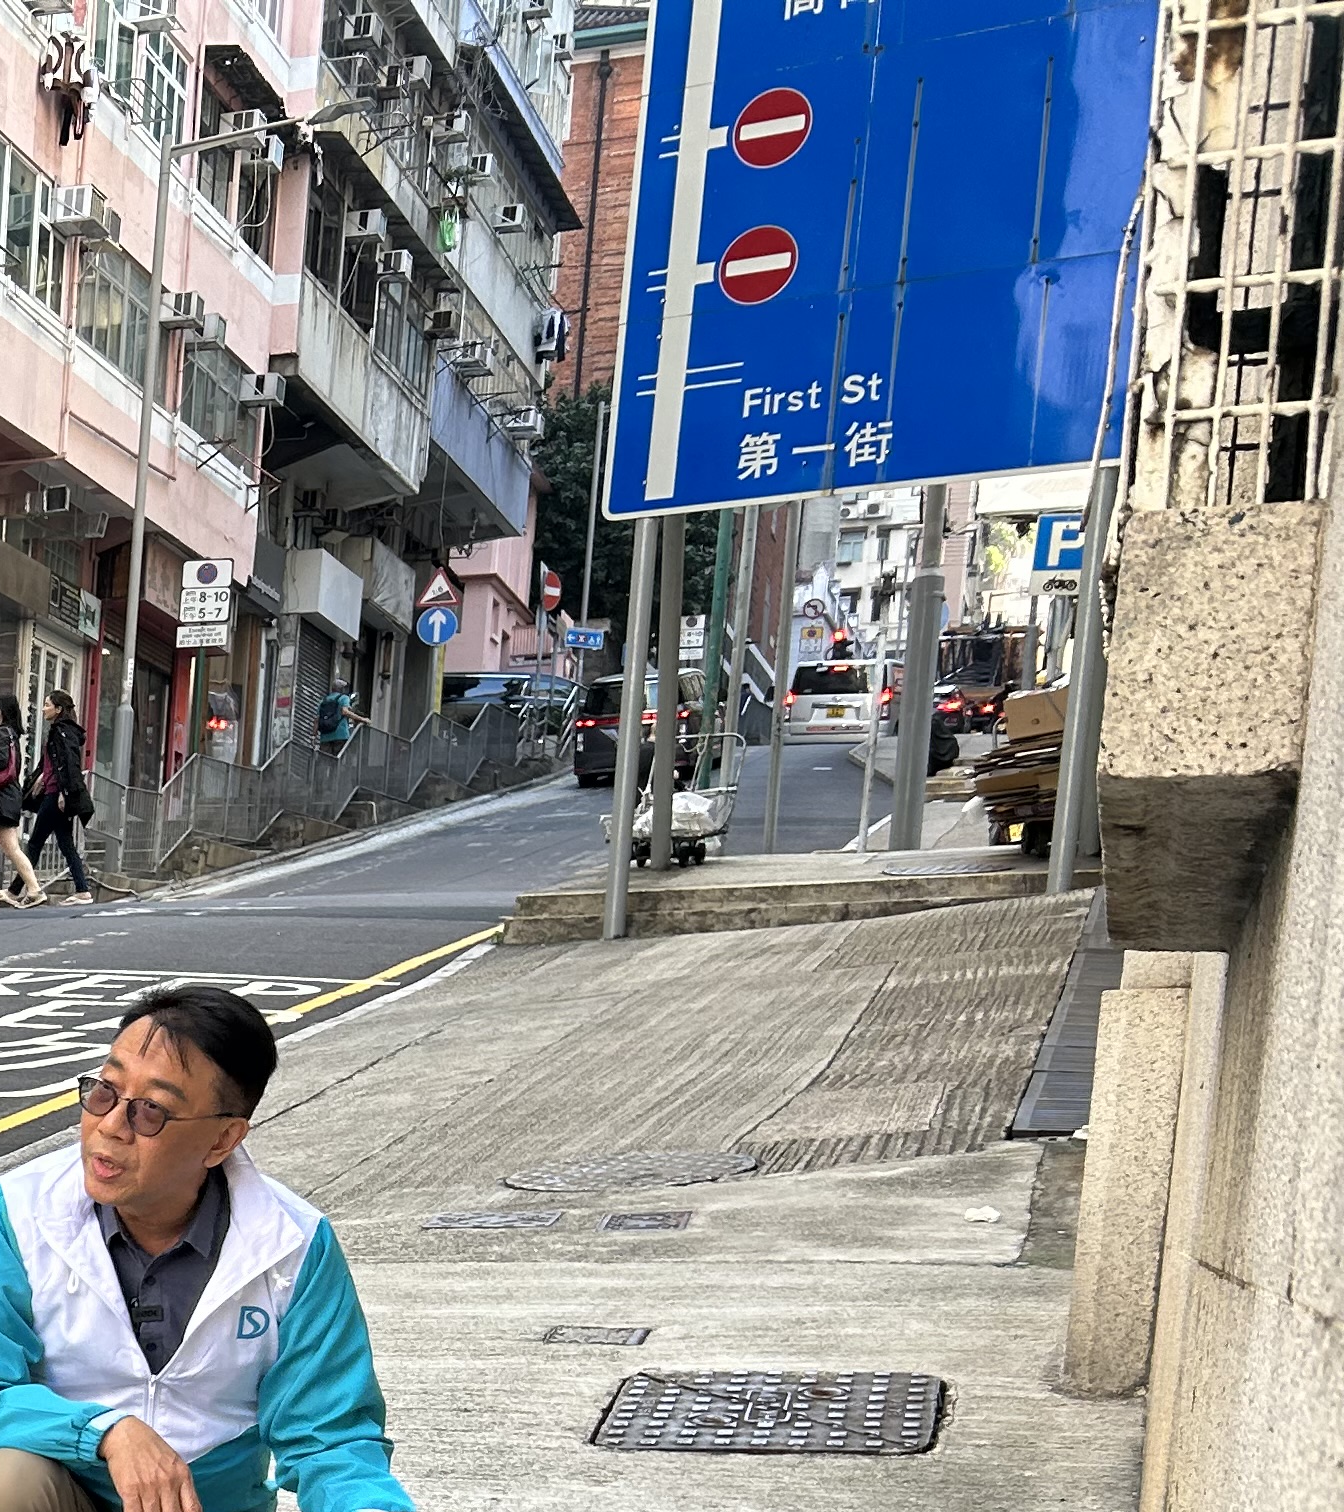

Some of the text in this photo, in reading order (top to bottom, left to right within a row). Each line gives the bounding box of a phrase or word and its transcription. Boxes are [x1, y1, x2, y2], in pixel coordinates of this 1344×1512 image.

[742, 372, 883, 418] First St
[737, 420, 893, 480] 第一街
[1047, 521, 1086, 566] P
